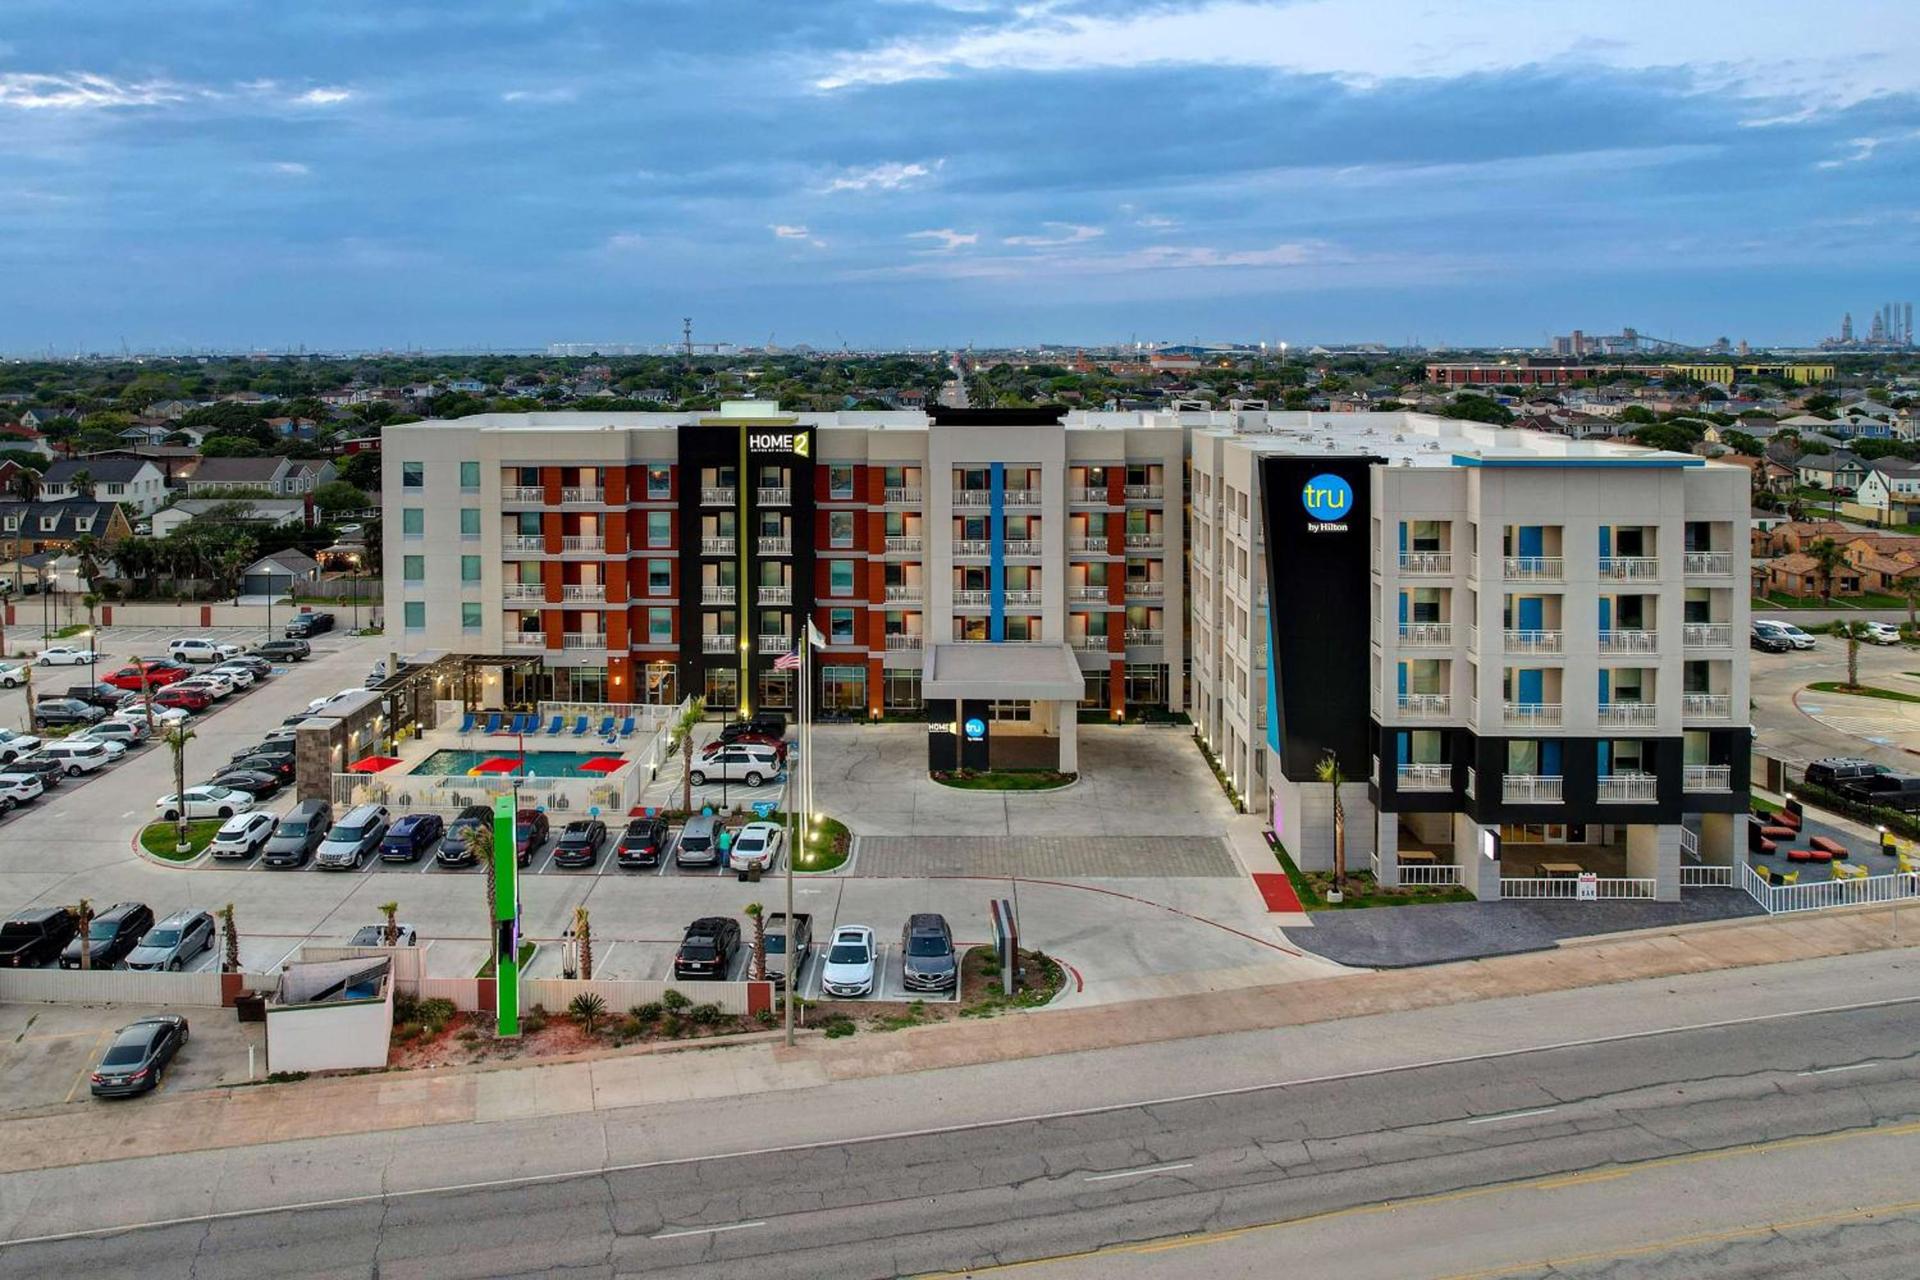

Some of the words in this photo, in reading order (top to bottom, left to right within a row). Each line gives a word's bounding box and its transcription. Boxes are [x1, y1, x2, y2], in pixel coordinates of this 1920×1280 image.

[1304, 484, 1344, 508] tru
[1308, 523, 1319, 533] by
[1320, 523, 1348, 531] Hilton
